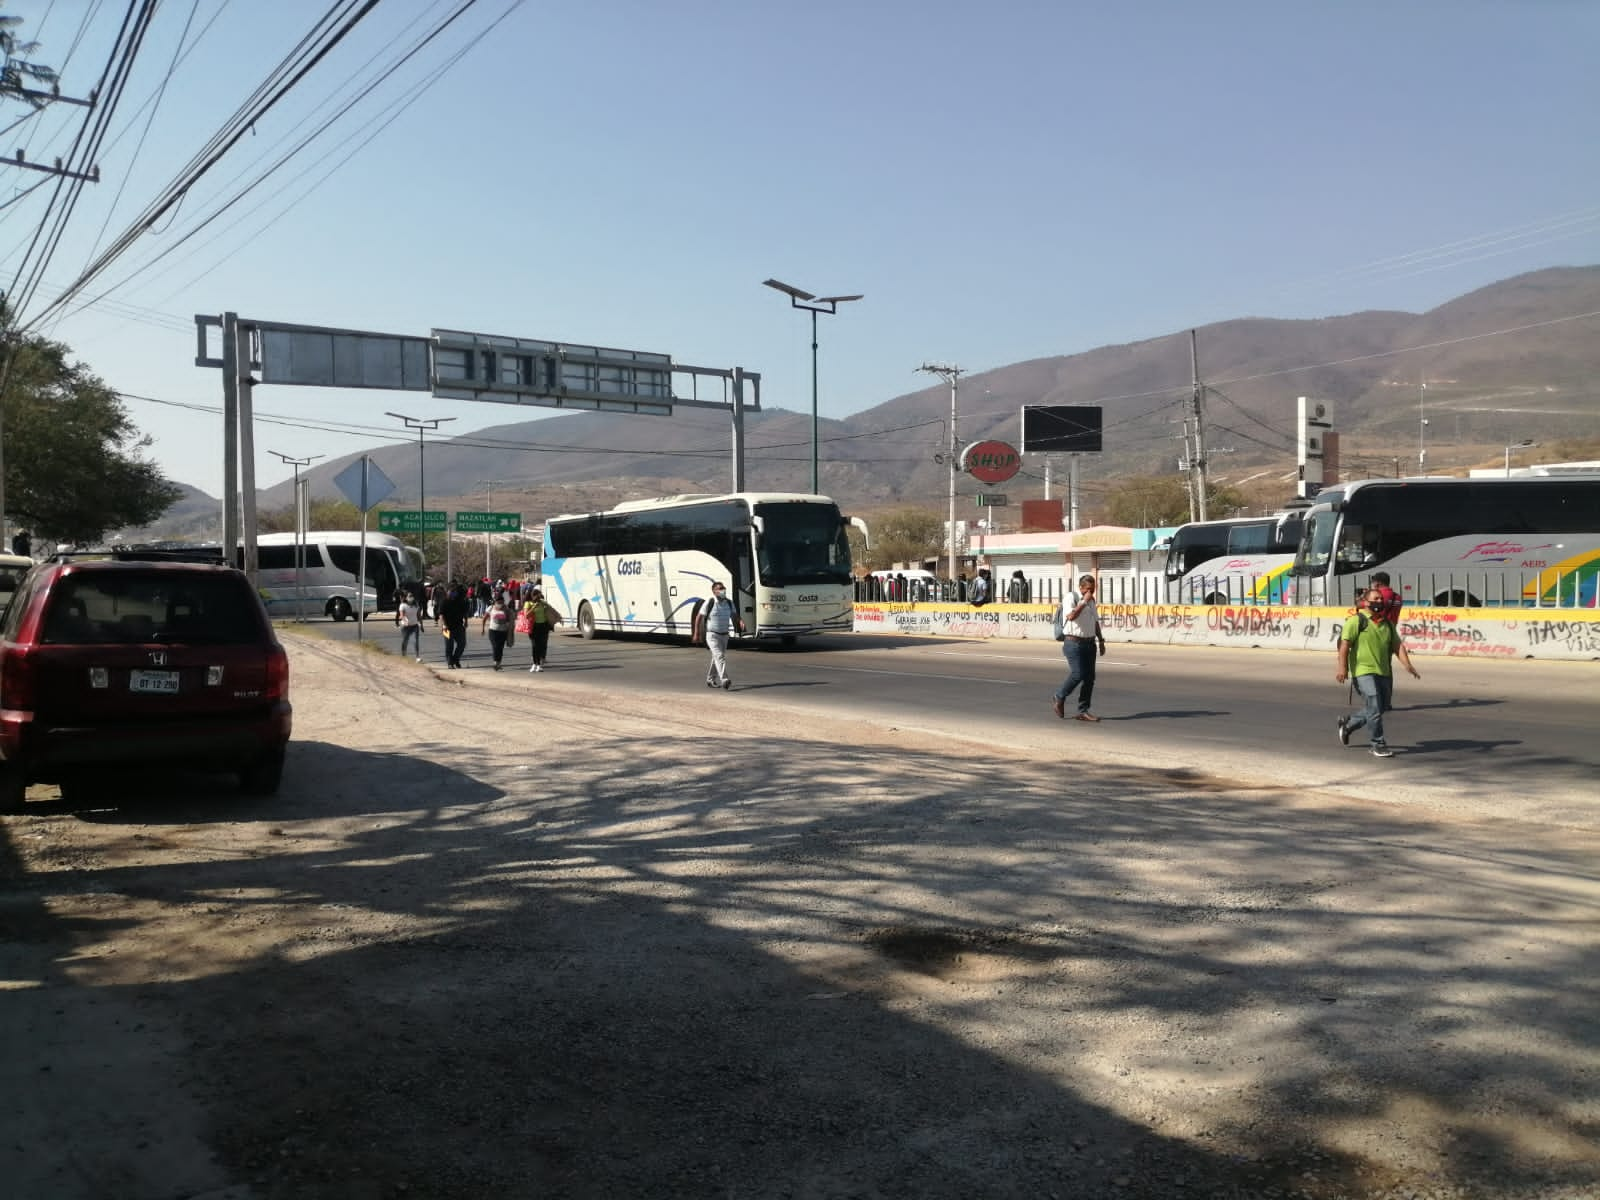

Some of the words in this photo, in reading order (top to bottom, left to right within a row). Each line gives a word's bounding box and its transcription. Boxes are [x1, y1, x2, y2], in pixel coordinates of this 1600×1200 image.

[971, 453, 1015, 467] SHOP
[617, 558, 642, 575] Costa
[798, 594, 818, 602] Costa
